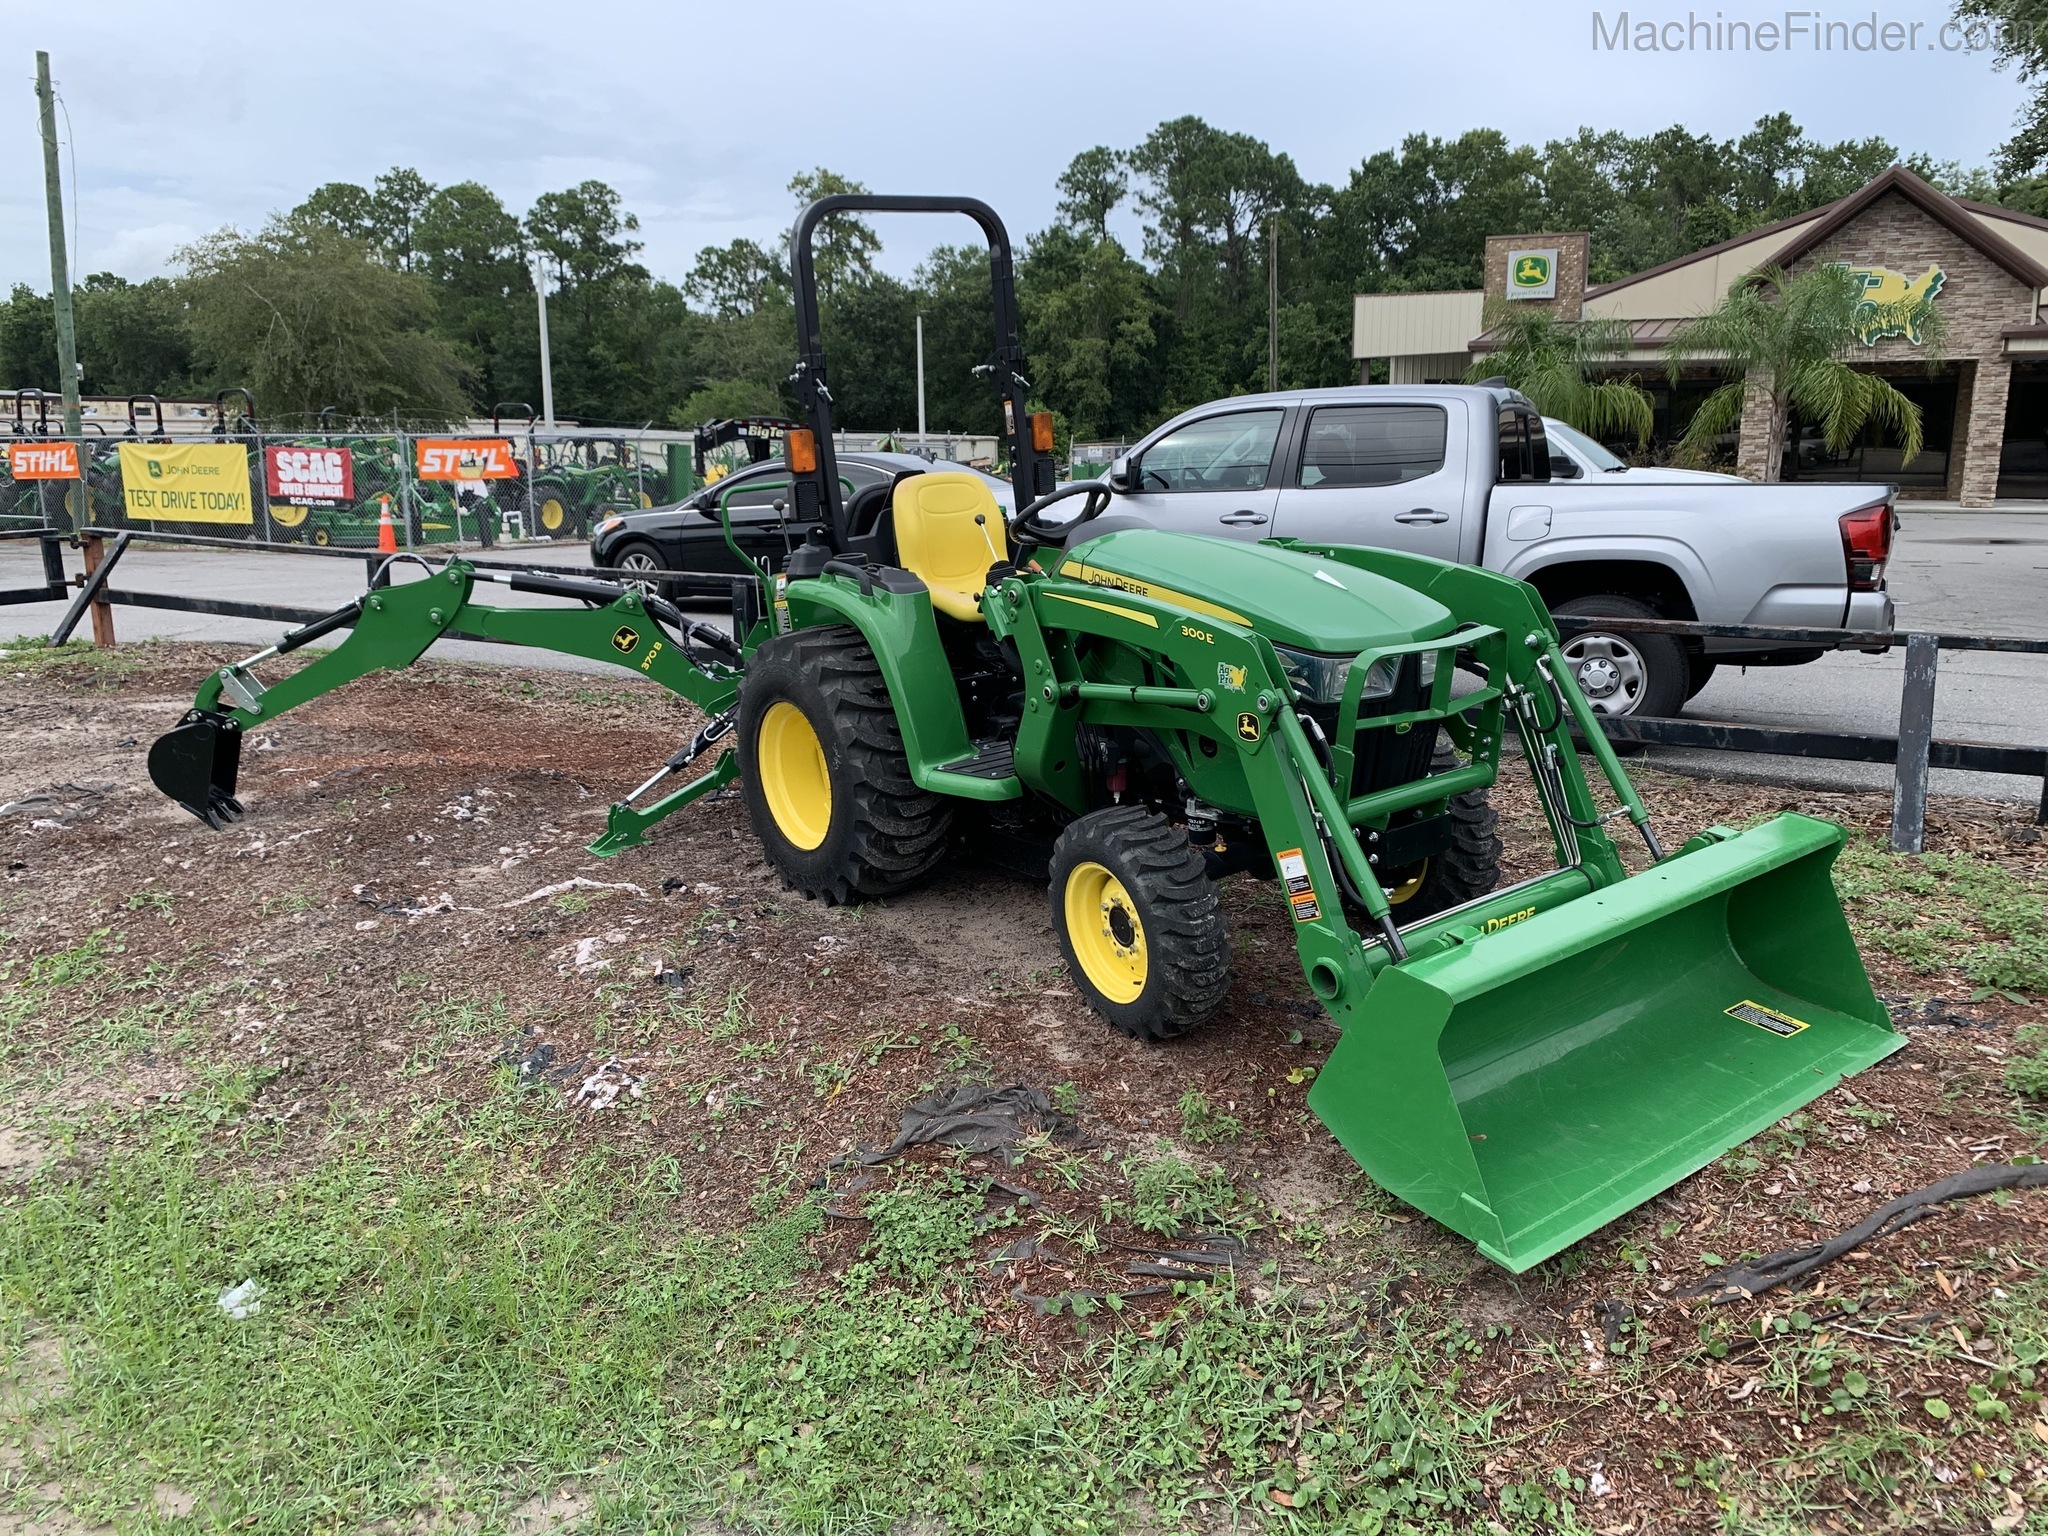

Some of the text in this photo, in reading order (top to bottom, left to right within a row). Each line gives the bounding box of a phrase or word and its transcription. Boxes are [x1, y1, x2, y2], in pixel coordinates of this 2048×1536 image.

[748, 425, 785, 440] BigTe
[14, 449, 75, 473] STIHL
[166, 464, 220, 475] JOHN DEERE
[276, 451, 343, 484] SCAG
[128, 488, 246, 512] TEST DRIVE TODAY!
[278, 482, 344, 498] POWER EQUIPMENT
[289, 496, 335, 507] SCAG.com
[1088, 570, 1149, 597] JOHN DEERE
[1219, 673, 1234, 685] Pro
[1487, 906, 1536, 933] DEERE
